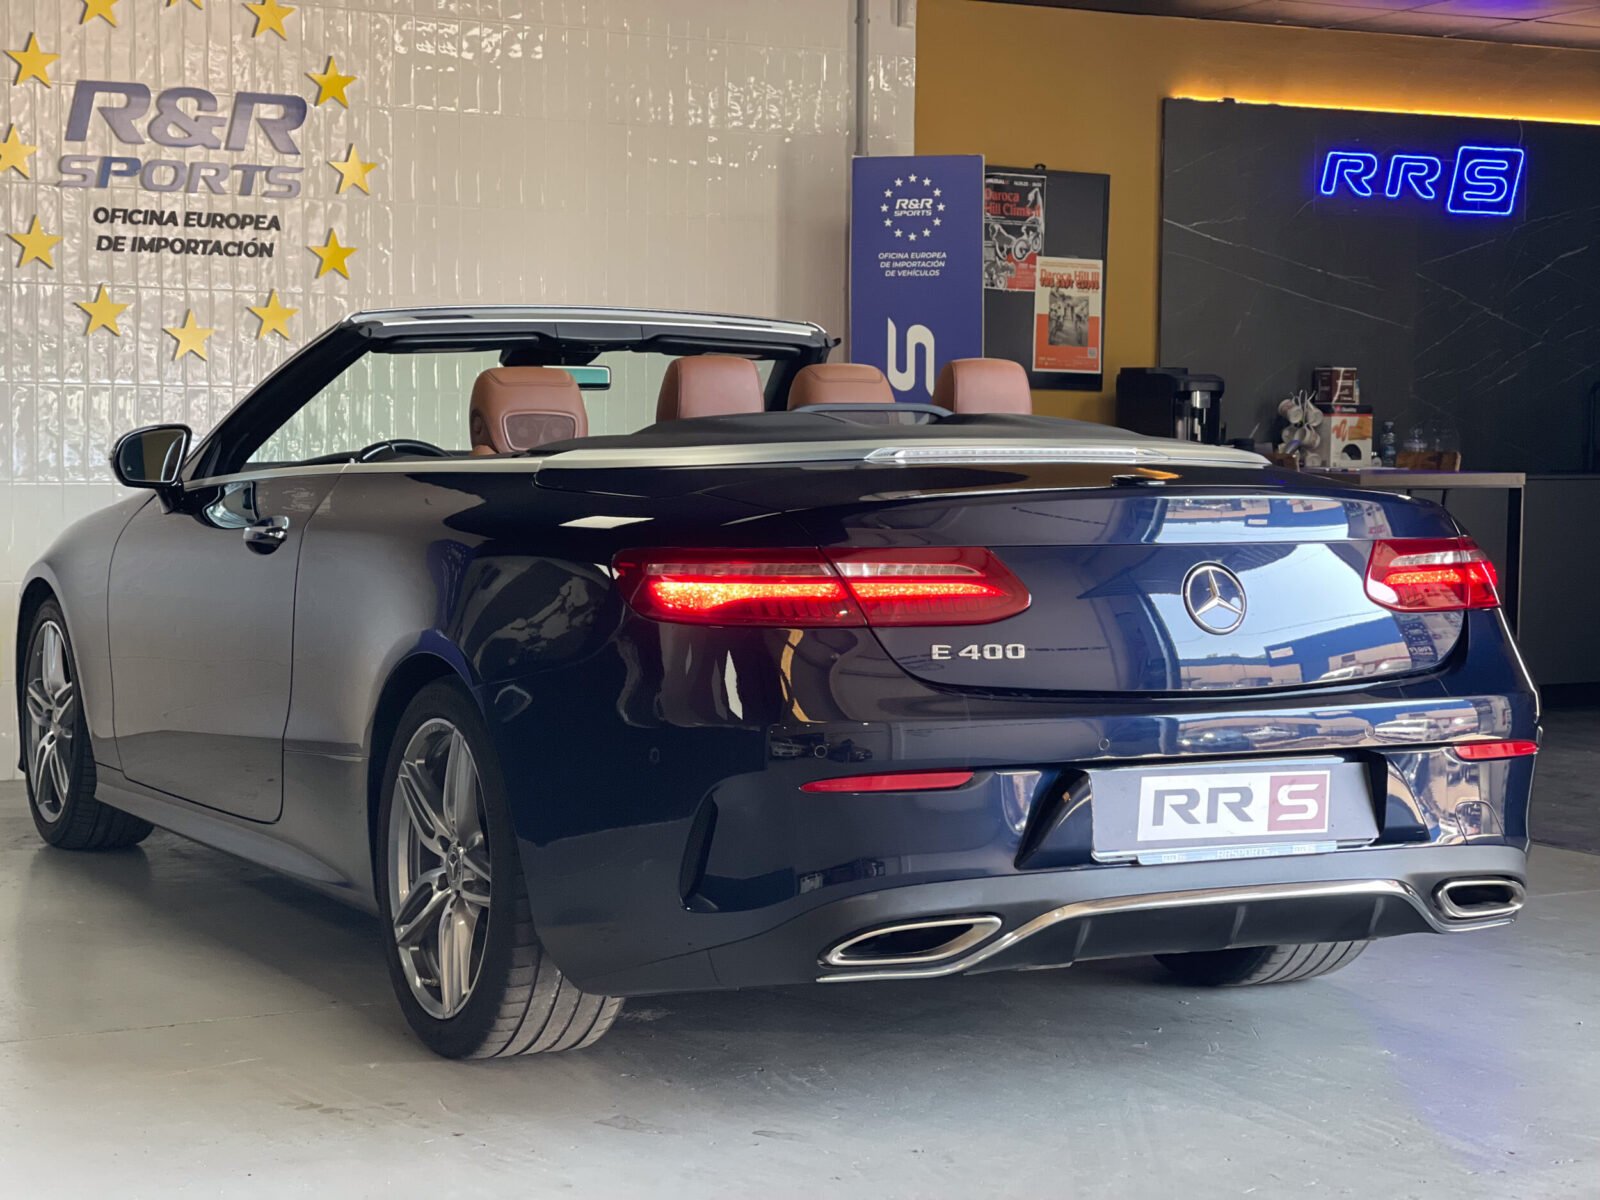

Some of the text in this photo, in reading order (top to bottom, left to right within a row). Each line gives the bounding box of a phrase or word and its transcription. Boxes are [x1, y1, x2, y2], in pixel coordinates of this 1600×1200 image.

[64, 79, 308, 155] R&R
[56, 154, 304, 198] SPORTS
[895, 198, 934, 210] R&R
[93, 207, 282, 232] OFICINA EUROPEA
[894, 209, 933, 217] SPORTS
[96, 235, 275, 258] DE IMPORTACIÓN
[878, 251, 947, 260] OFICINA EUROPEA
[892, 259, 946, 268] IMPORTACIÓN
[897, 268, 941, 277] VEHÍCULOS
[931, 643, 1025, 661] E 400
